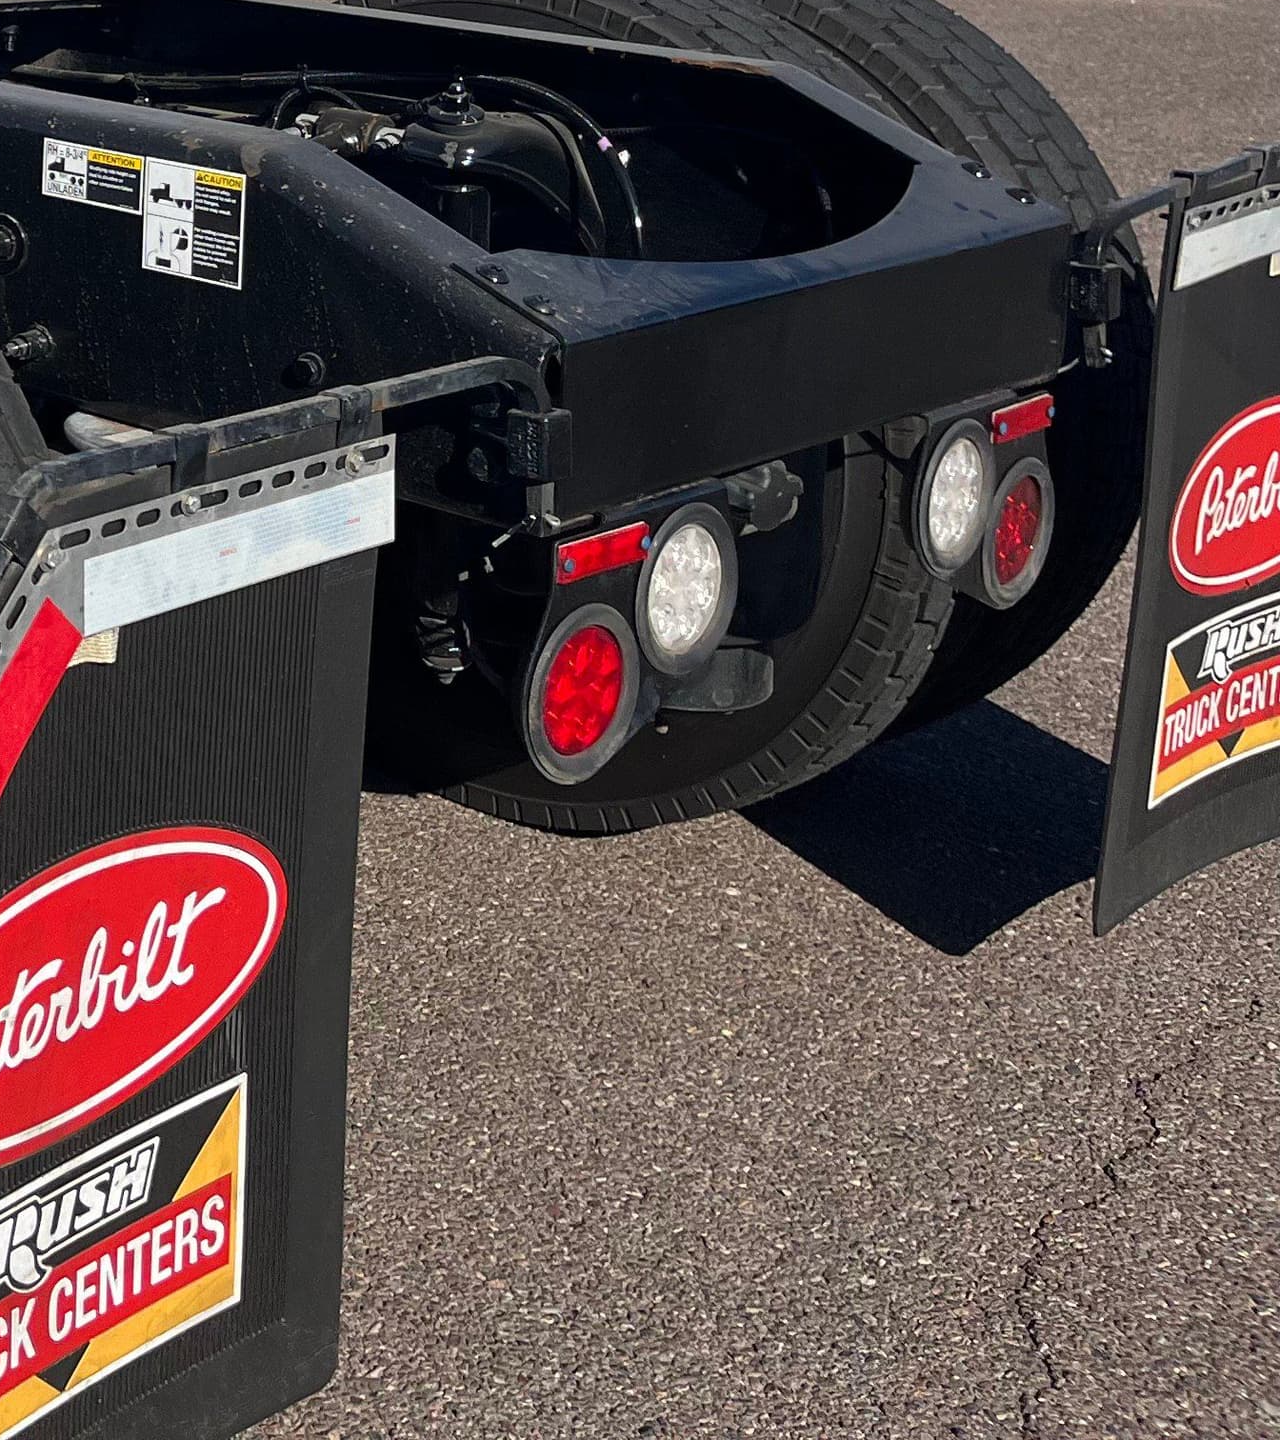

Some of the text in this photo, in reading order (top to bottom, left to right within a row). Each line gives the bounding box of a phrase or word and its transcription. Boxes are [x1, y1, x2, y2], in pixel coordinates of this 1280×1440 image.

[47, 143, 58, 156] RH
[92, 153, 136, 168] ATTENTION
[203, 173, 242, 188] CAUTION
[47, 182, 85, 197] UNLADEN
[1194, 450, 1280, 557] Peterb
[1164, 665, 1280, 757] TRUCK CENT
[48, 1194, 226, 1343] CENTERS
